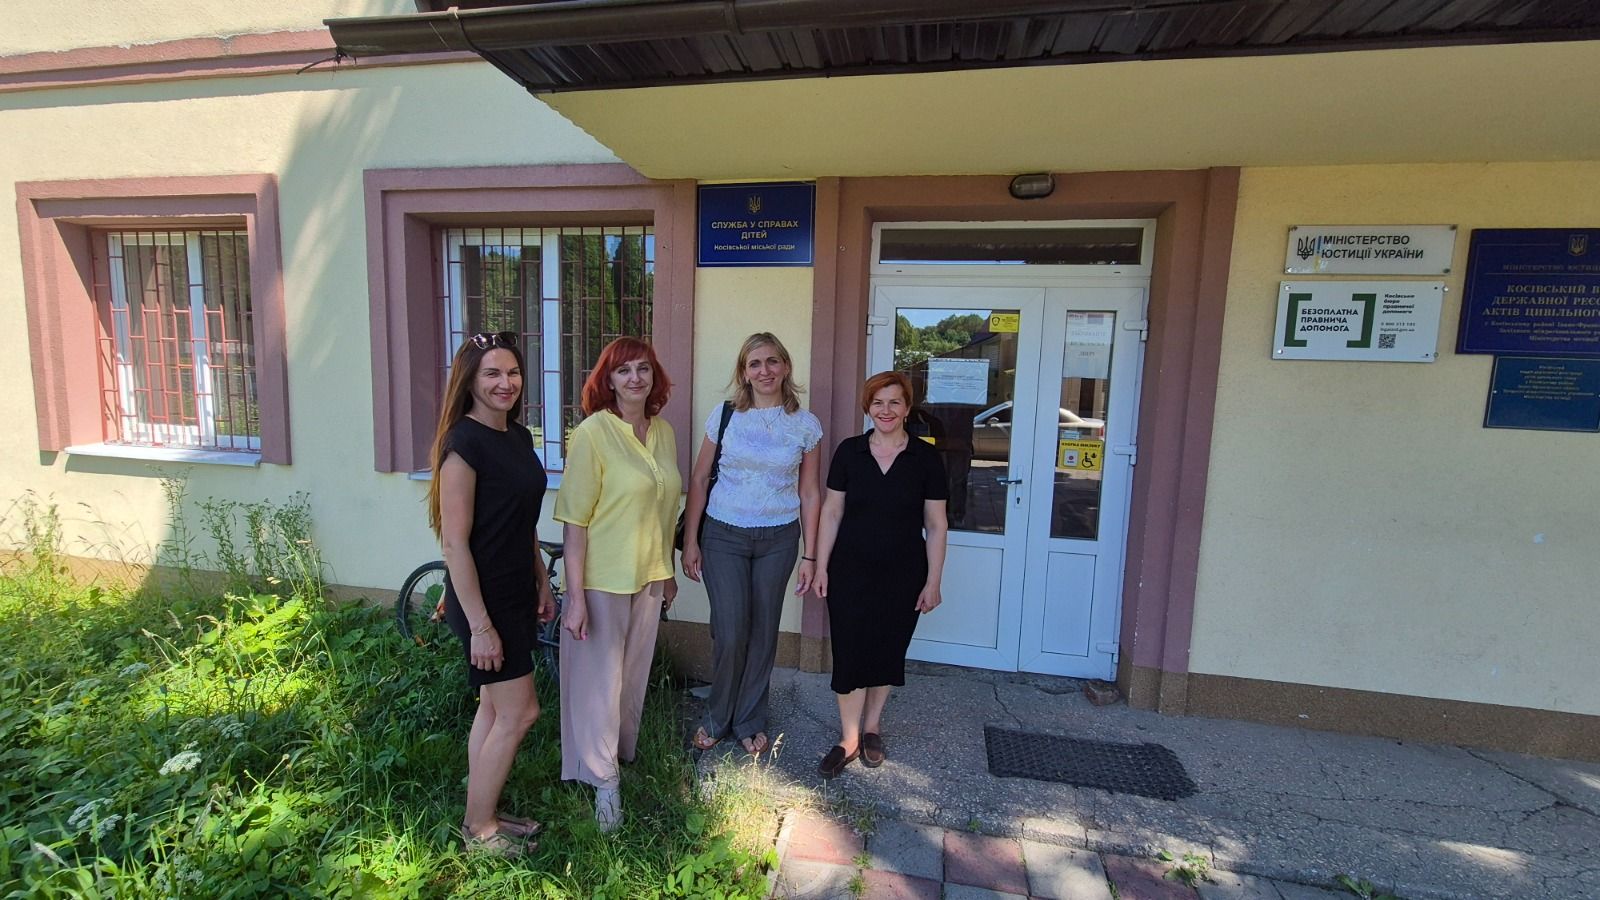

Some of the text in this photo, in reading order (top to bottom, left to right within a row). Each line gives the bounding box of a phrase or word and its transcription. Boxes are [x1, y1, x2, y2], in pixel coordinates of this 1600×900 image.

[711, 220, 799, 229] СЛУЖБА У СПРАВАХ
[741, 230, 768, 240] ДІТЕЙ
[1323, 235, 1410, 245] МІНІСТЕРСТВО
[751, 243, 777, 251] міської
[1321, 248, 1424, 261] ЮСТИЦІЇ УКРАЇНИ
[1507, 284, 1586, 294] КОСІВСЬКИЙ
[1491, 296, 1568, 306] ДЕРЖАВНОЇ
[1301, 308, 1359, 316] БЕЗОПЛАТНА
[1482, 307, 1600, 317] АКТІВ ЦИВІЛЬНОГ
[1300, 316, 1348, 324] ПРАВНИЧА
